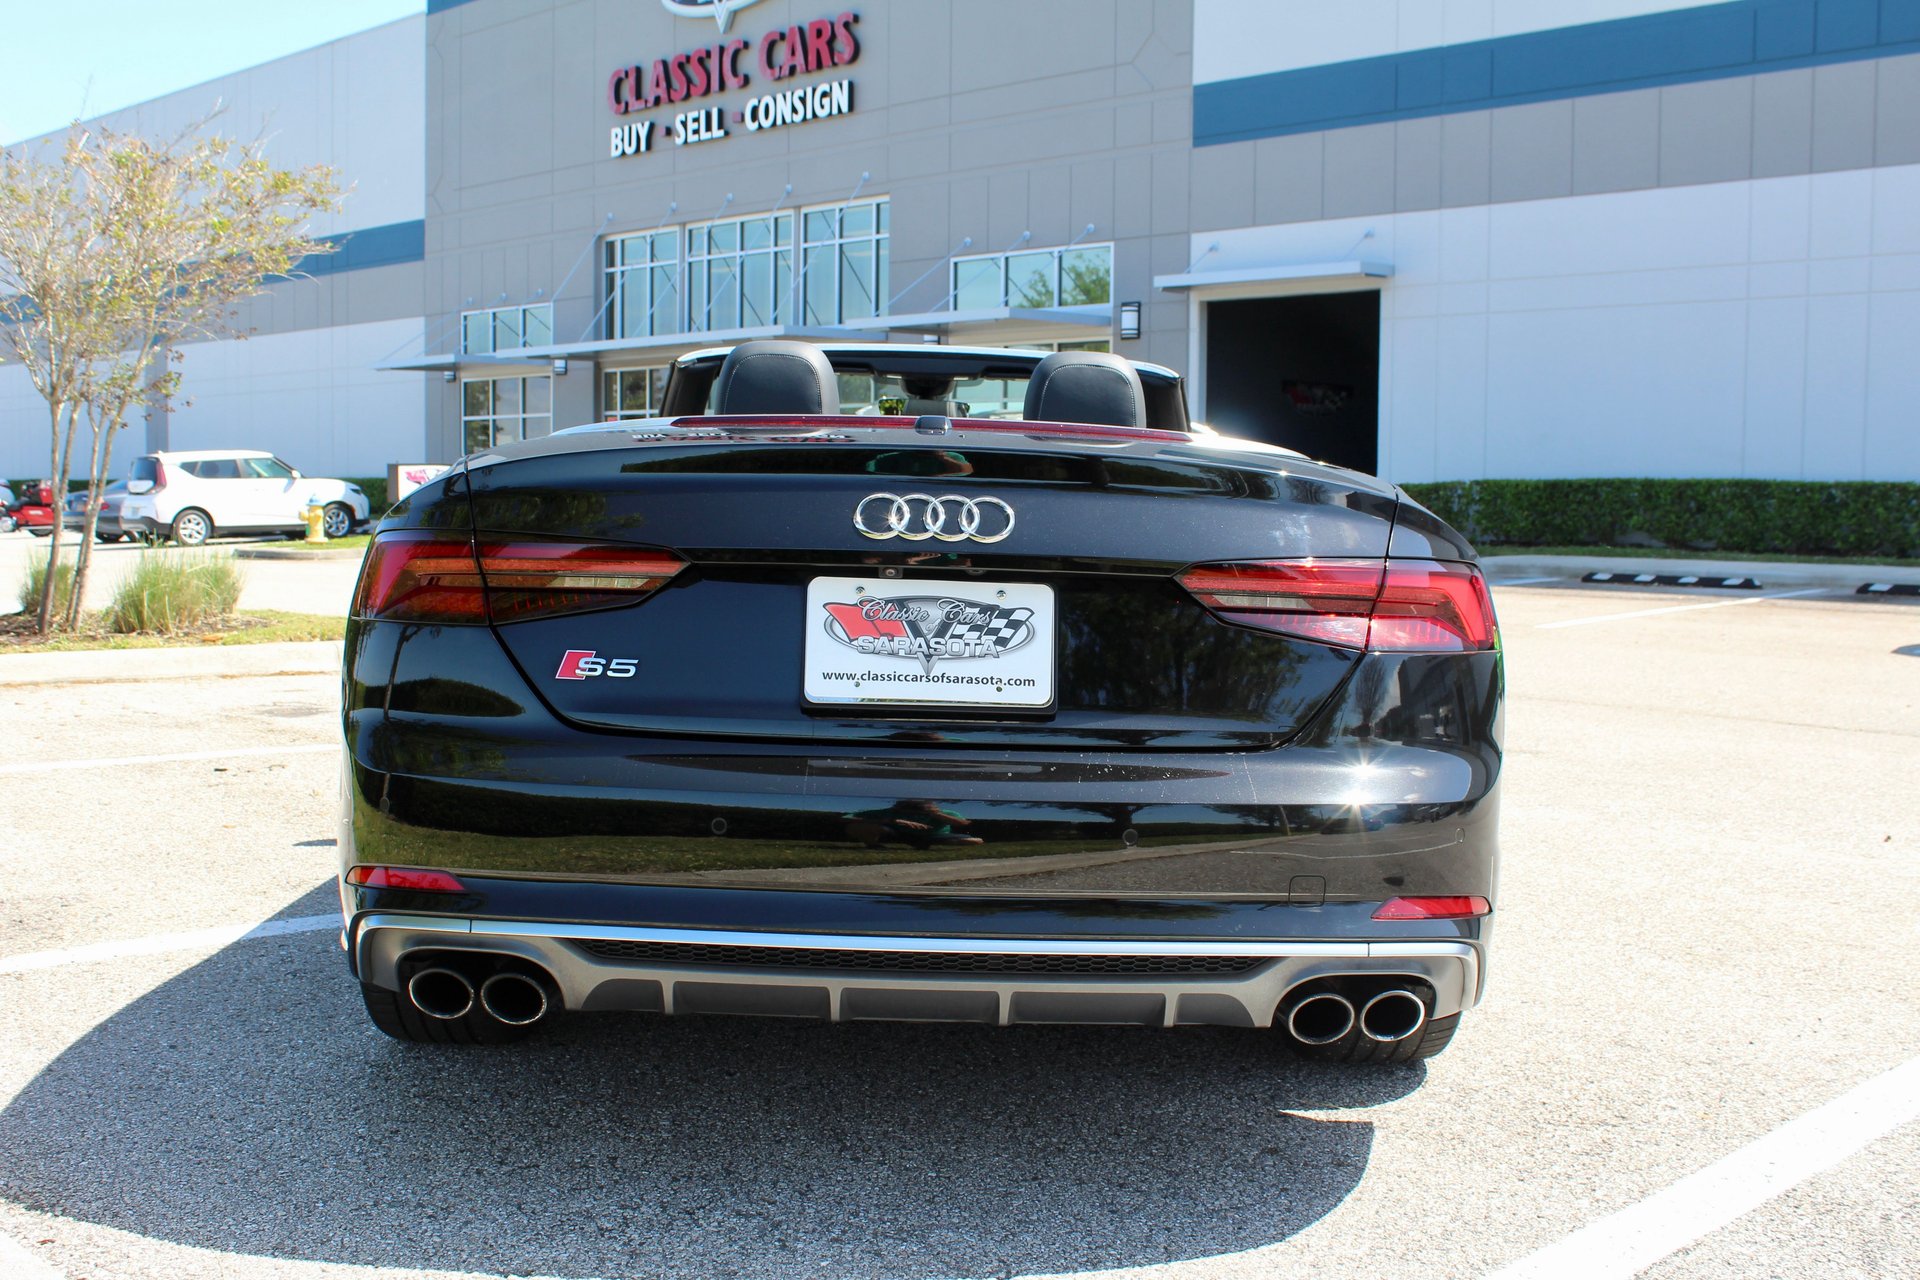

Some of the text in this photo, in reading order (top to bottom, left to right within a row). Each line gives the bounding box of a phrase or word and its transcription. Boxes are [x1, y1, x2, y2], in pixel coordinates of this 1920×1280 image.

[608, 12, 859, 115] CLASSIC CARS
[610, 80, 850, 157] BUY SELL CONSIGN
[858, 596, 991, 625] Classic Cars
[857, 635, 1000, 658] SARASOTA
[575, 657, 639, 677] S5
[822, 670, 1035, 687] www.classiccarsofsarasota.com
